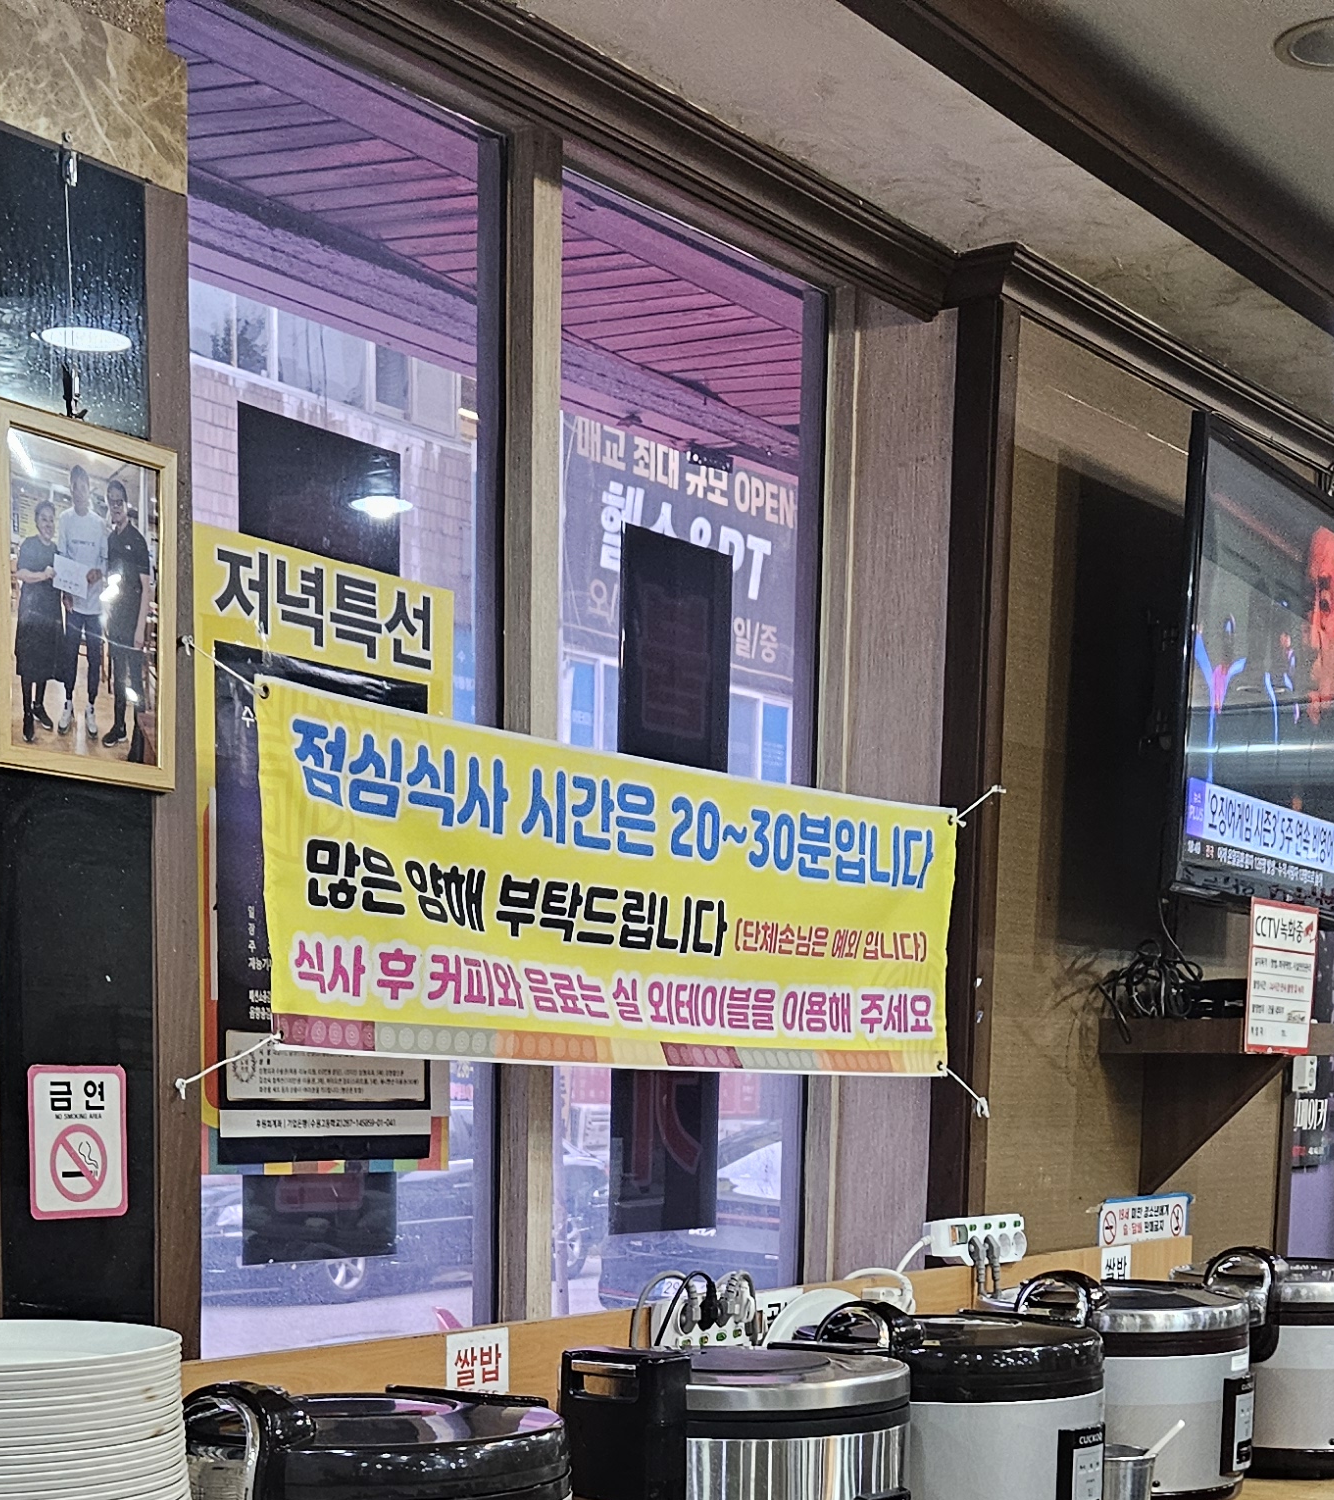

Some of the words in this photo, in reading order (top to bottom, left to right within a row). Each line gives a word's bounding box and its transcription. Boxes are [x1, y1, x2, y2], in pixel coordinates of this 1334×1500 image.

[576, 416, 627, 471] 매교
[633, 436, 680, 490] 최대
[734, 471, 796, 529] OPEN
[214, 547, 432, 671] 저녁특선
[292, 718, 509, 834] 점심식사
[522, 768, 656, 857] 시간은
[671, 796, 934, 889] 20~30분입니다
[1295, 821, 1312, 856] 연속
[307, 839, 405, 915] 많은
[405, 861, 485, 932] 양해
[496, 875, 727, 957] 부탁드립니다
[736, 918, 830, 958] (단체손님은
[832, 928, 863, 959] 예외
[863, 931, 927, 962] 입니다)
[294, 940, 365, 997] 식사
[376, 948, 416, 1000] 후
[428, 954, 524, 1009] 커피와
[525, 967, 610, 1018] 음료는
[783, 990, 851, 1033] 이용해
[860, 993, 933, 1034] 주세요
[454, 1343, 502, 1387] 쌀밥
